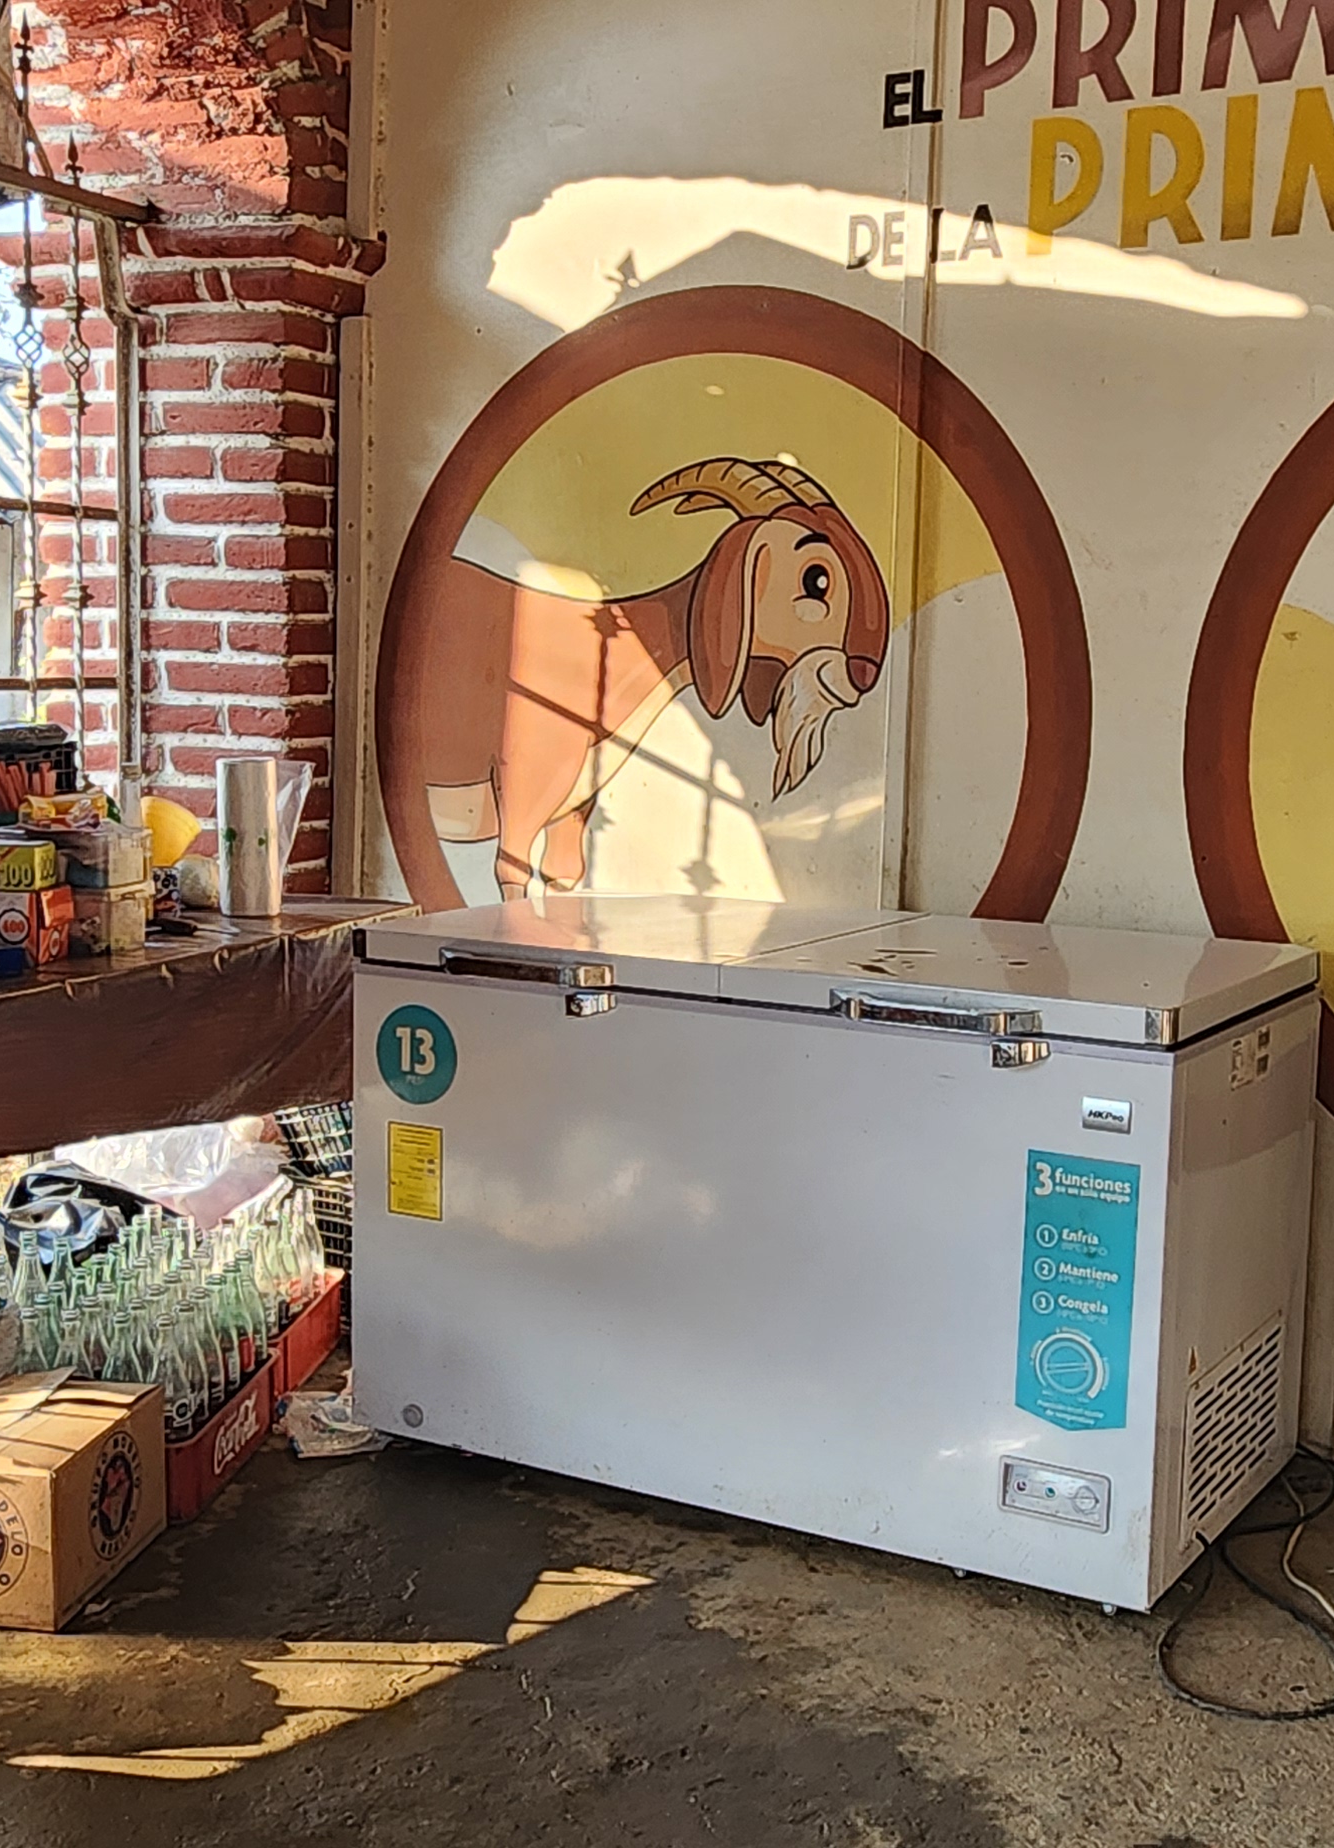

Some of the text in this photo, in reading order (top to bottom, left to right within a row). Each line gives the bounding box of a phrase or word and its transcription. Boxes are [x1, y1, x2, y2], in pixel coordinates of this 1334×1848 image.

[883, 69, 943, 128] EL
[846, 210, 905, 270] DE
[928, 203, 1003, 264] LA
[395, 1026, 436, 1075] 13
[1034, 1160, 1131, 1196] 3 funciones
[1059, 1261, 1120, 1284] Mantiene
[1057, 1294, 1109, 1315] Congela
